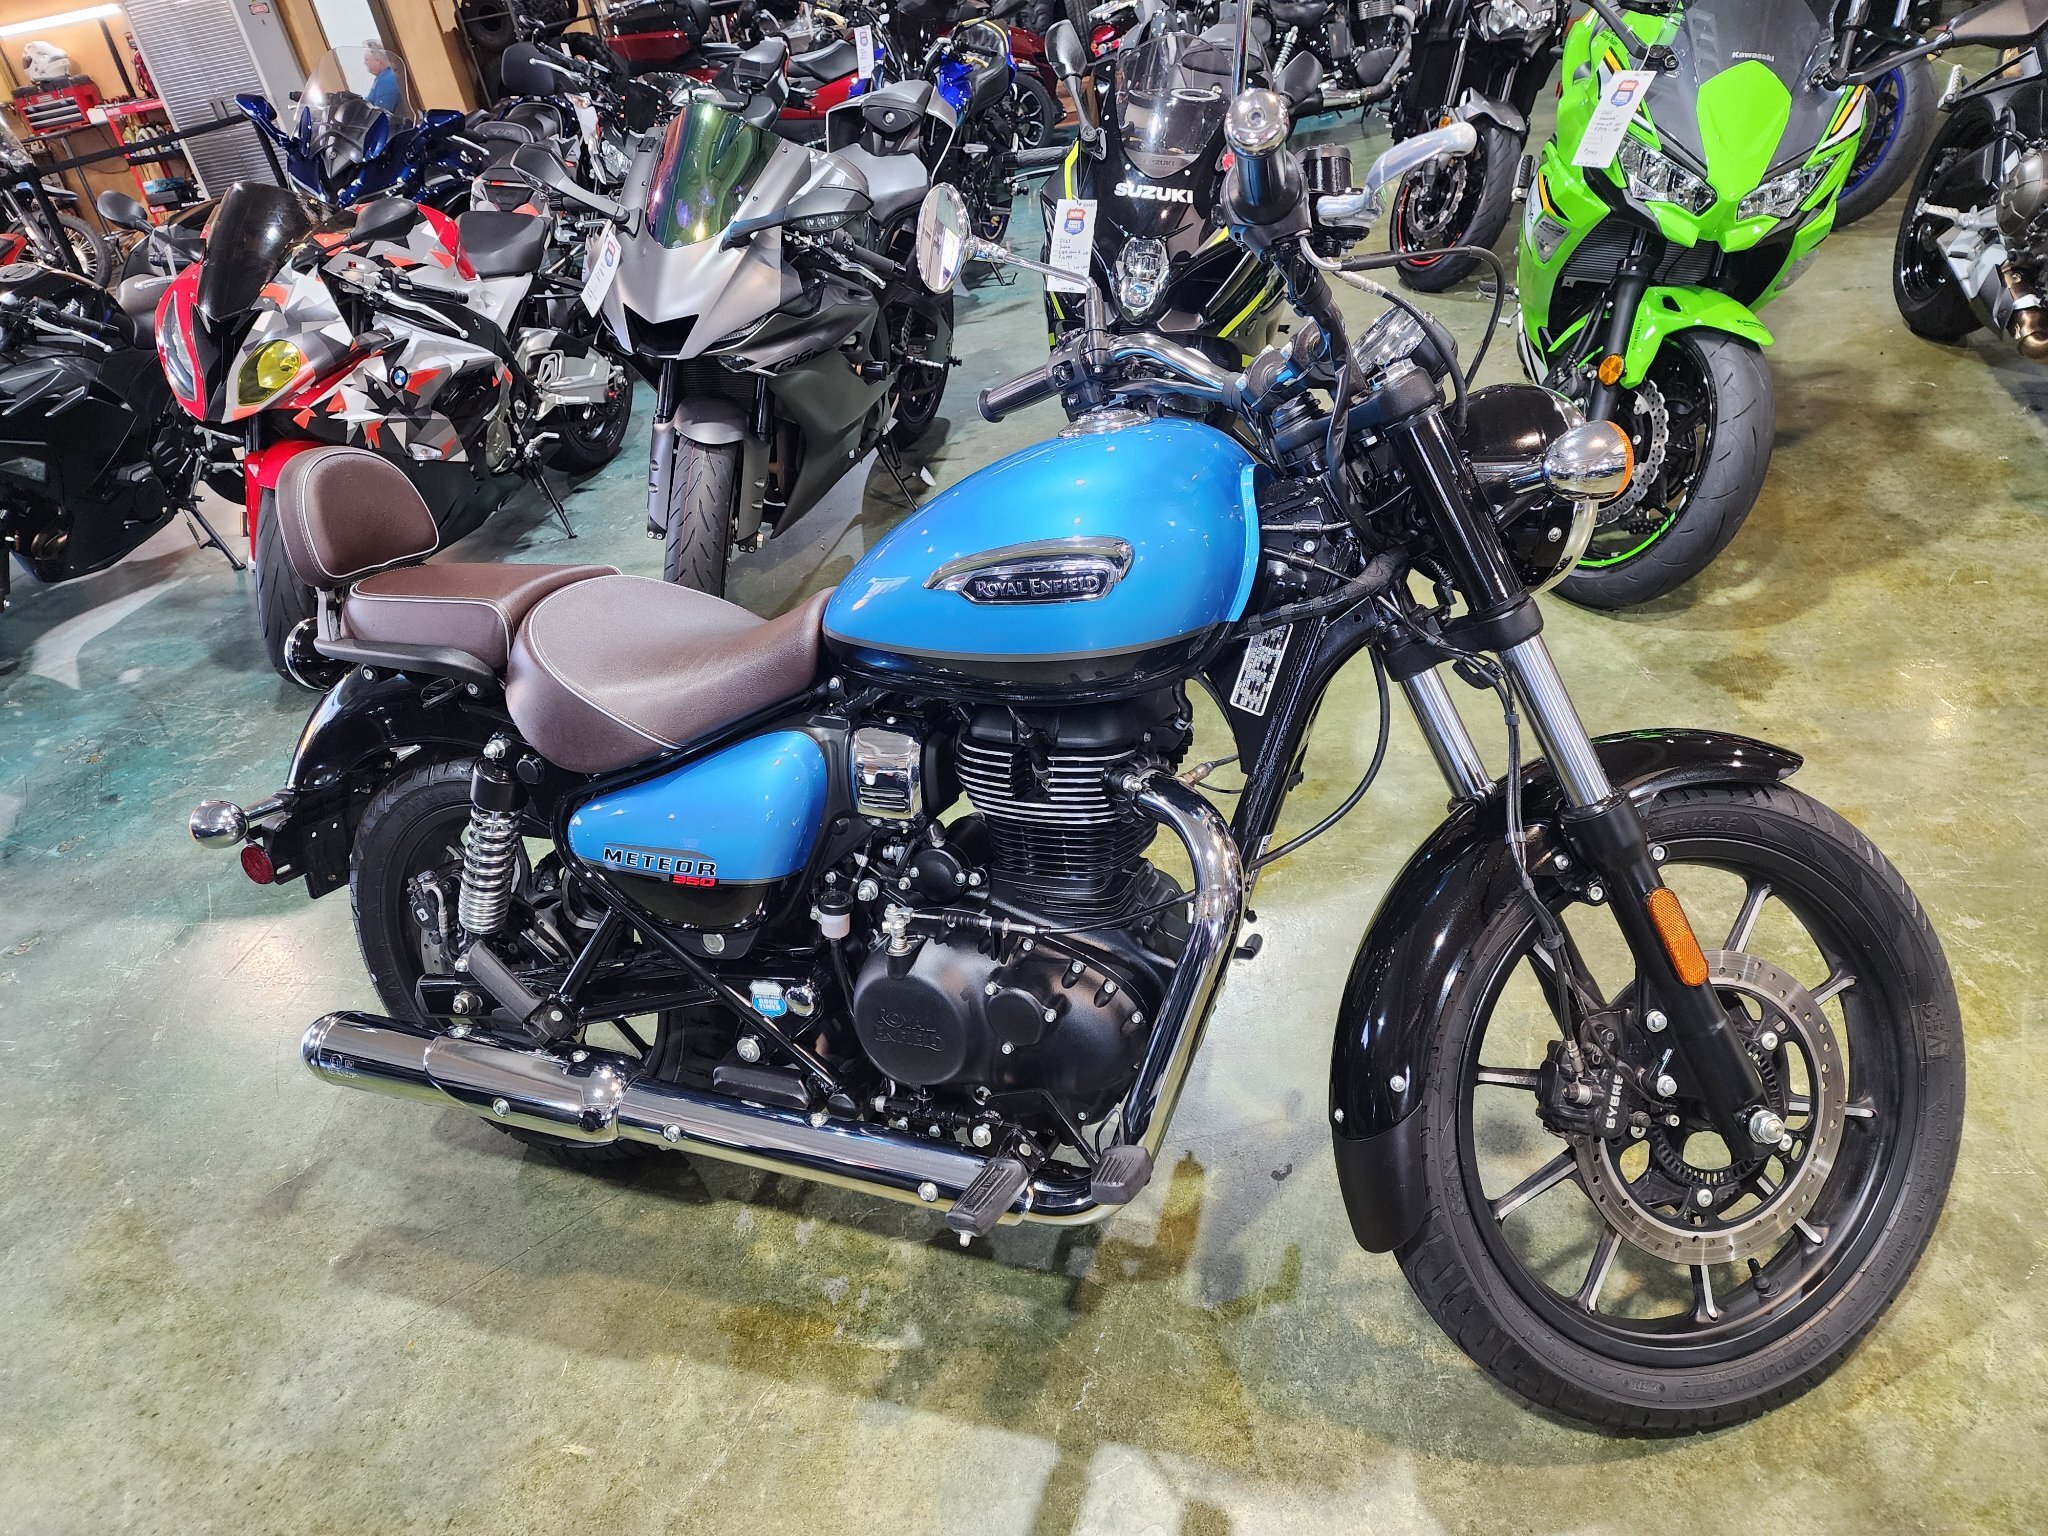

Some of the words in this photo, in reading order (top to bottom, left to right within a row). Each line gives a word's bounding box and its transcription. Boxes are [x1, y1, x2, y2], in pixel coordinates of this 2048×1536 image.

[1732, 51, 1775, 62] Kawasaki
[1113, 182, 1194, 204] SUZUKI
[974, 579, 1028, 598] ROYAL
[1028, 575, 1101, 597] ENFIELD
[603, 847, 718, 877] METEOR
[672, 874, 716, 887] 350
[1605, 1074, 1624, 1129] BYBRE
